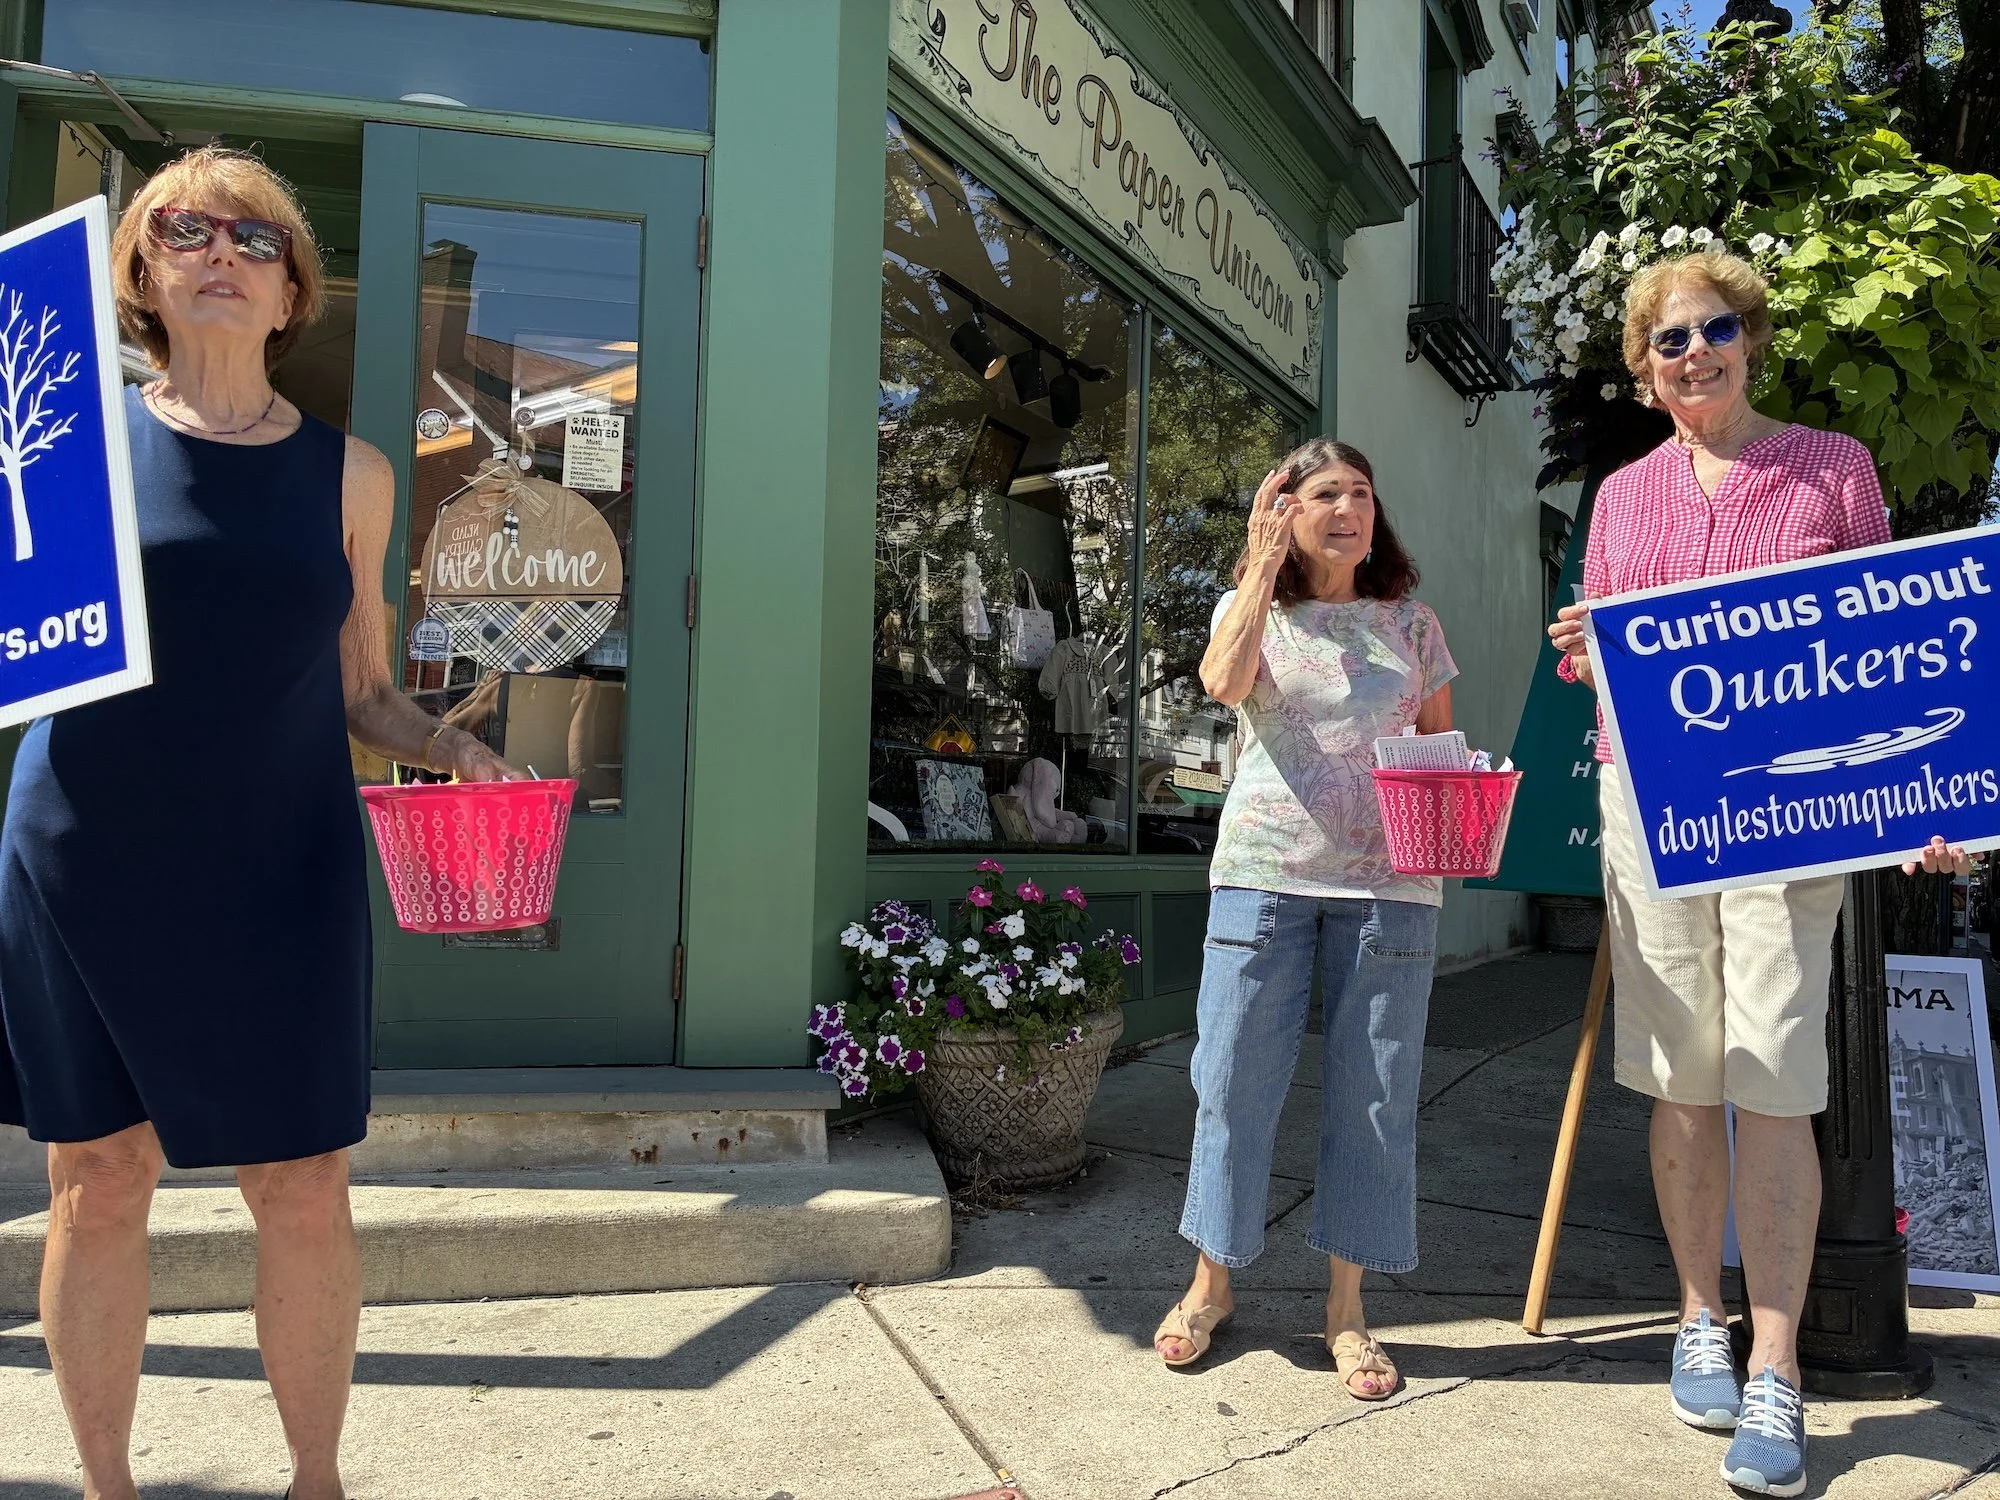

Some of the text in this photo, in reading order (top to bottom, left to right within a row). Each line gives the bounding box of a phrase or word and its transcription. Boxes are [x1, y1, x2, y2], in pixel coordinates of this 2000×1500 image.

[975, 0, 1294, 337] The Paper Unicorn
[571, 426, 619, 438] WANTED
[581, 416, 610, 427] HELP
[437, 532, 606, 591] welcome
[1624, 556, 1992, 656] Curious about
[1670, 617, 1979, 732] Quakers?
[1658, 763, 1999, 865] doylestownquakers
